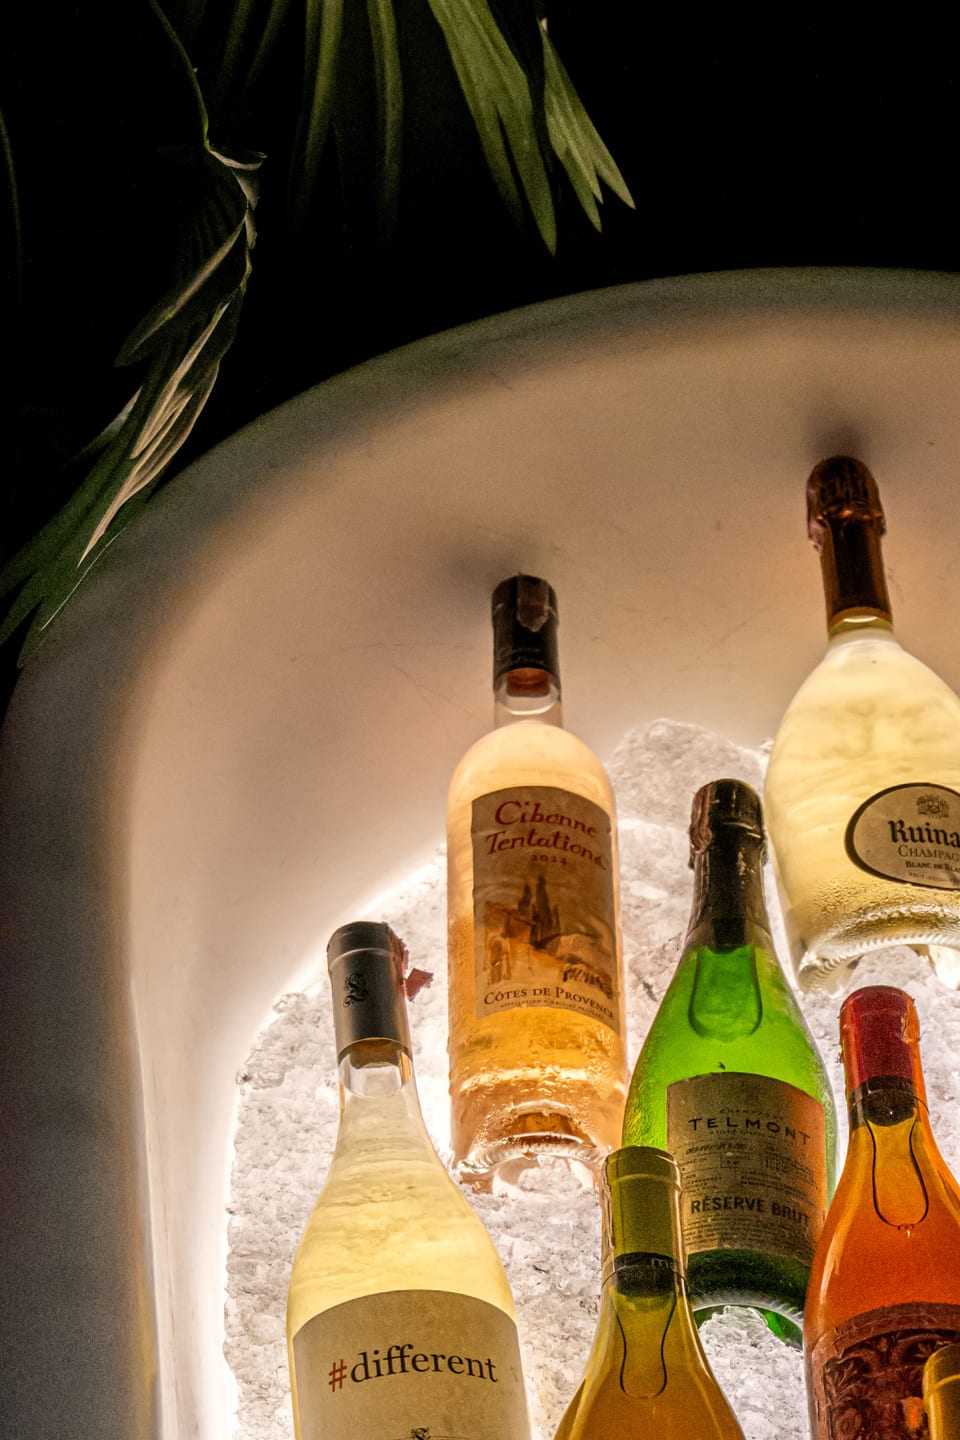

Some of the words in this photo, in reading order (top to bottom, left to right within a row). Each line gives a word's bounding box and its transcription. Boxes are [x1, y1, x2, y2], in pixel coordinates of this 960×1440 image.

[494, 800, 597, 838] Cibonne
[905, 860, 932, 869] BLANC
[484, 989, 527, 1005] CÔTES
[533, 987, 551, 997] DE
[556, 987, 614, 1019] PROVENCE
[688, 1117, 810, 1146] TELMONT
[691, 1196, 768, 1214] RÉSERVE
[771, 1203, 810, 1225] BRUT
[328, 1343, 498, 1392] #different
